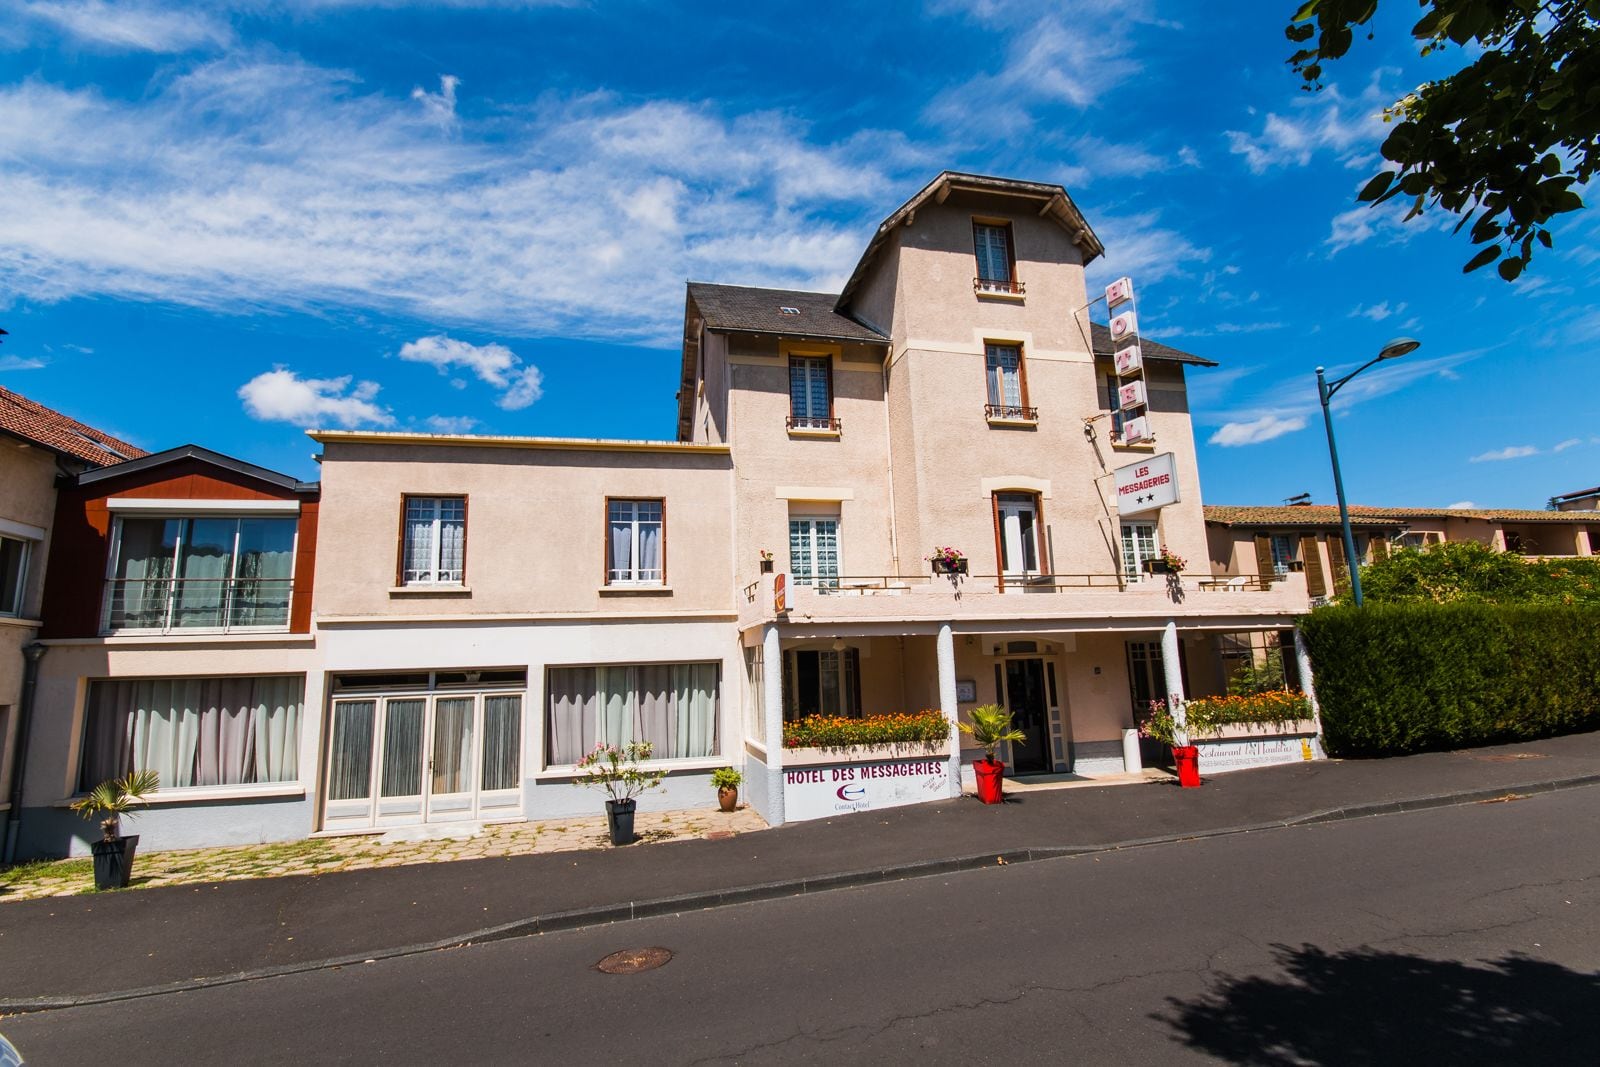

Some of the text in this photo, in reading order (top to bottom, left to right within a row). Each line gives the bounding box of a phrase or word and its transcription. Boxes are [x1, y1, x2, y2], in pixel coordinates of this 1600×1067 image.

[1107, 281, 1142, 440] HOTEL
[1135, 466, 1149, 478] LES
[1118, 473, 1170, 496] MESSAGERIES
[787, 761, 942, 784] HOTEL DES MESSAGERIES
